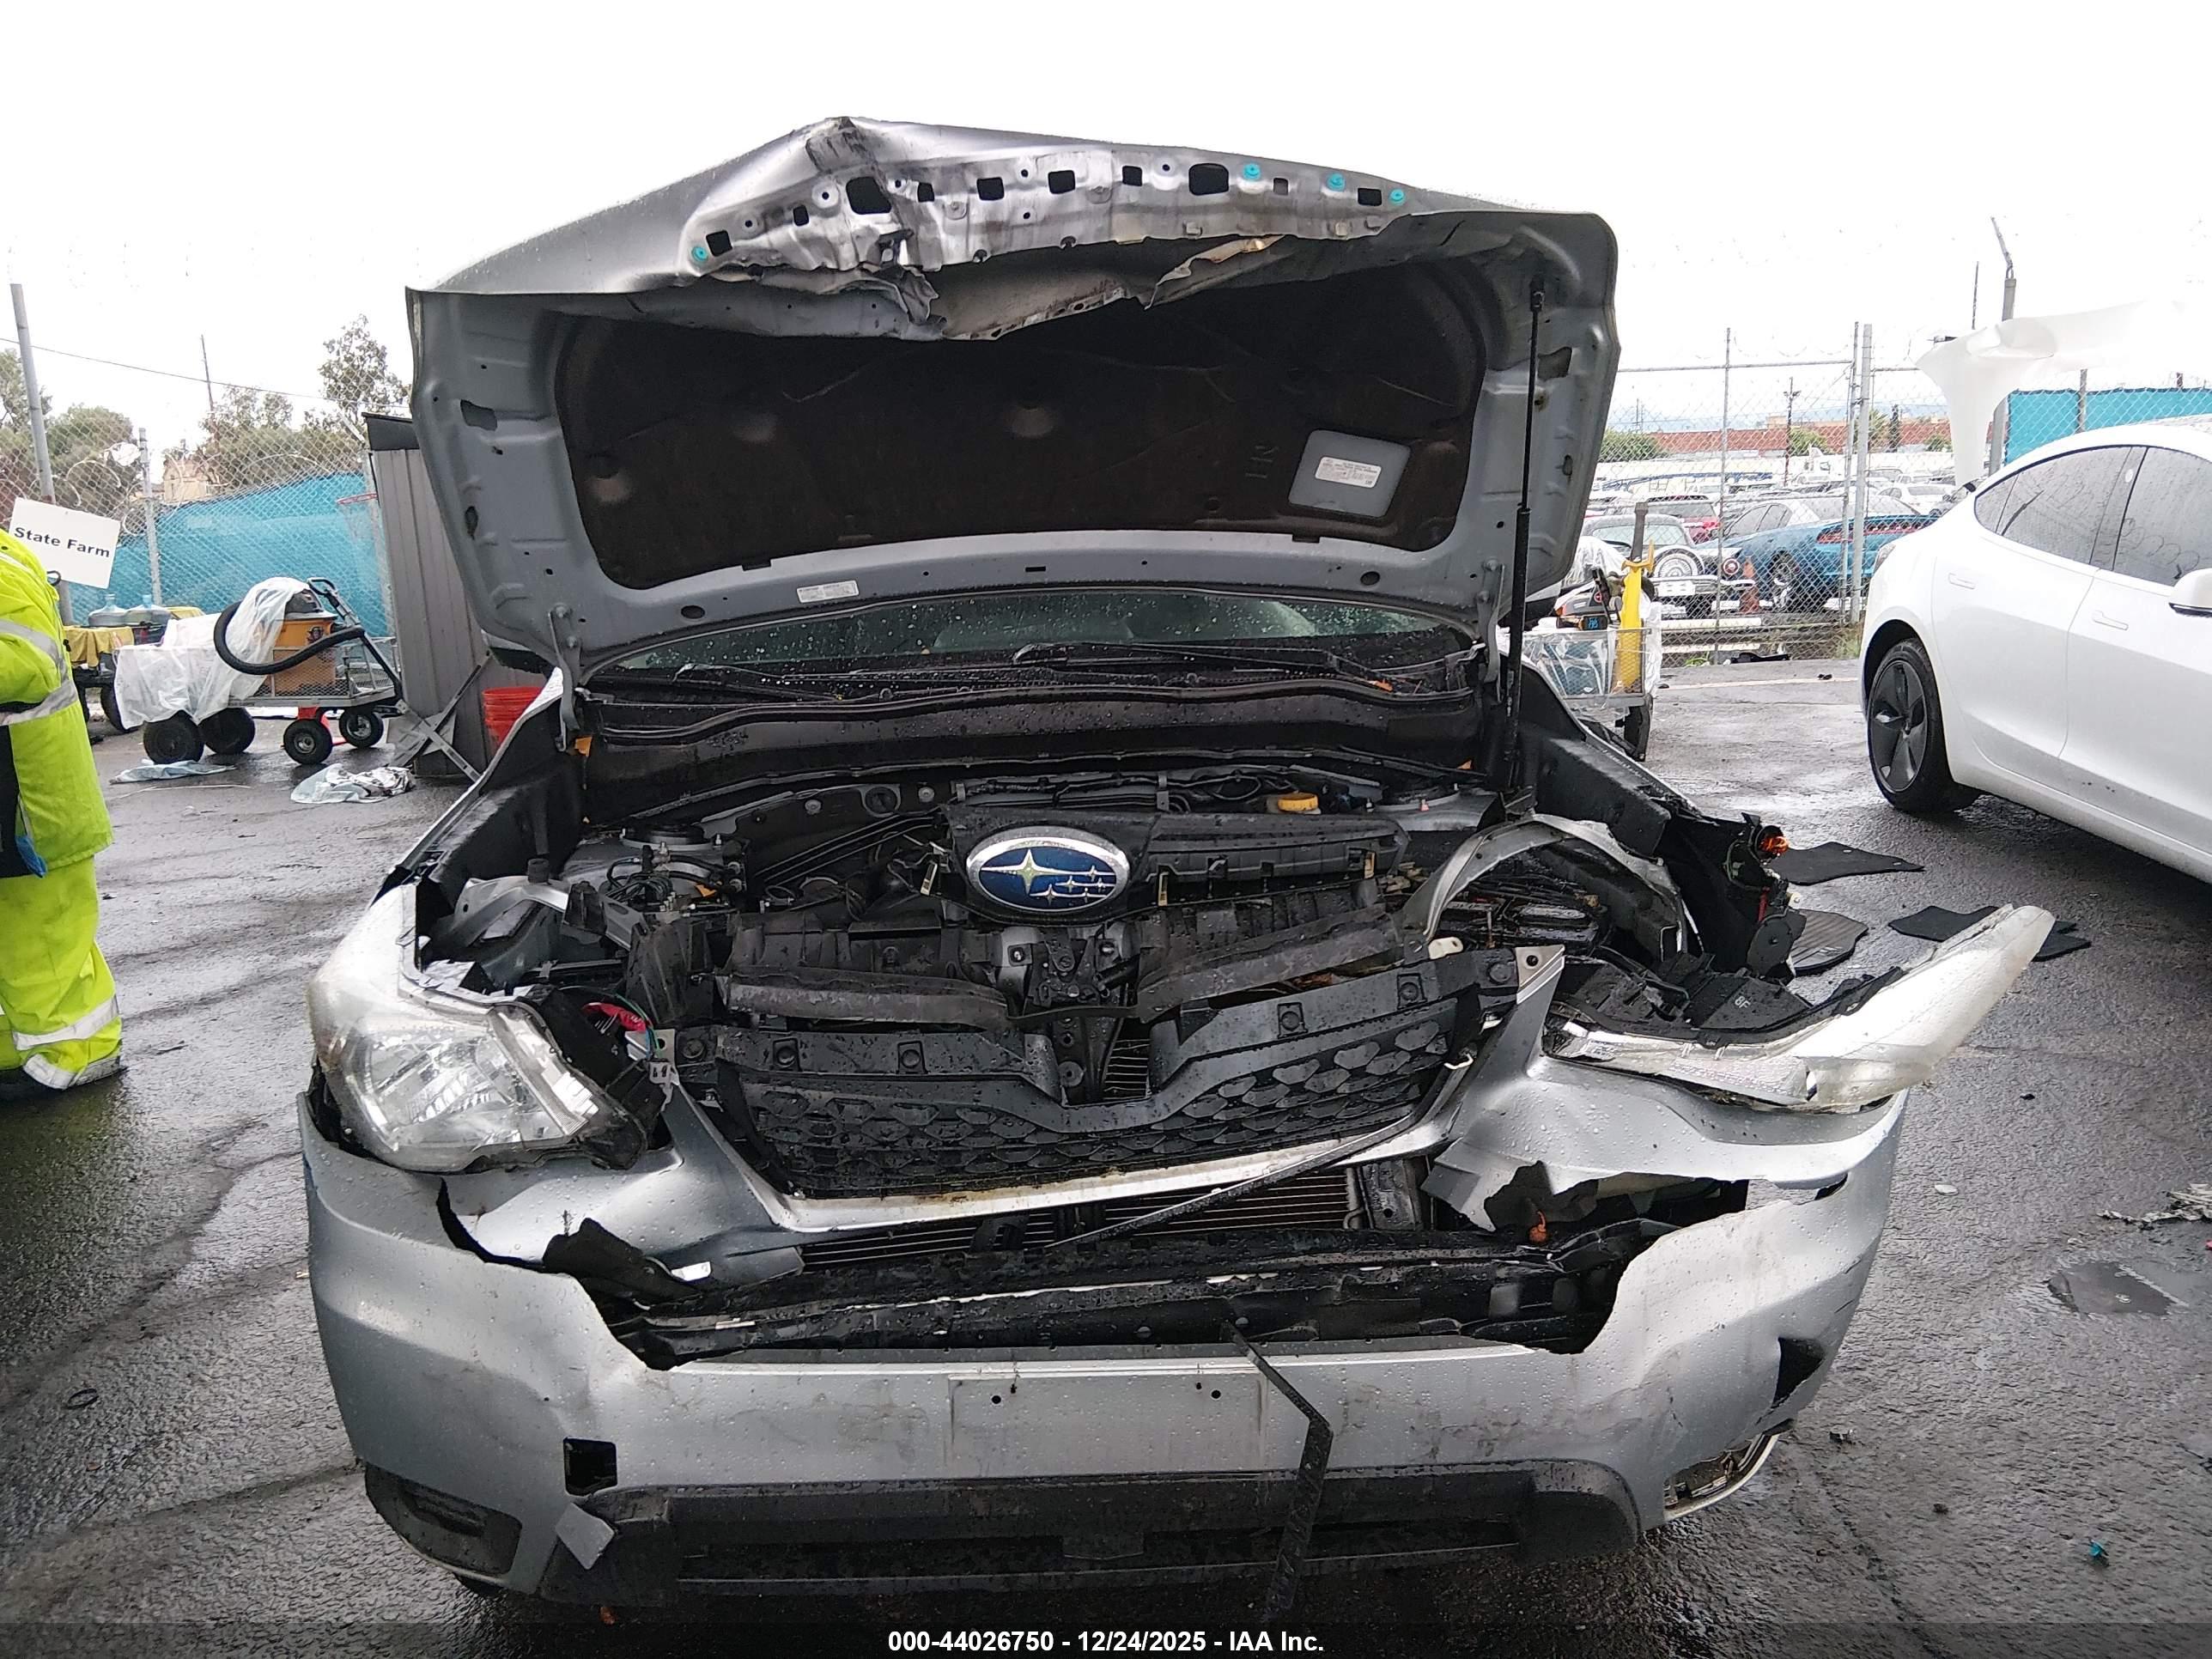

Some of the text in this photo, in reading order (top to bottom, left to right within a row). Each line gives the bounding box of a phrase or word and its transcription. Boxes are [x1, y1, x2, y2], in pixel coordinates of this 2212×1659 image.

[14, 526, 110, 557] State Farm
[1735, 995, 1751, 1008] 8F
